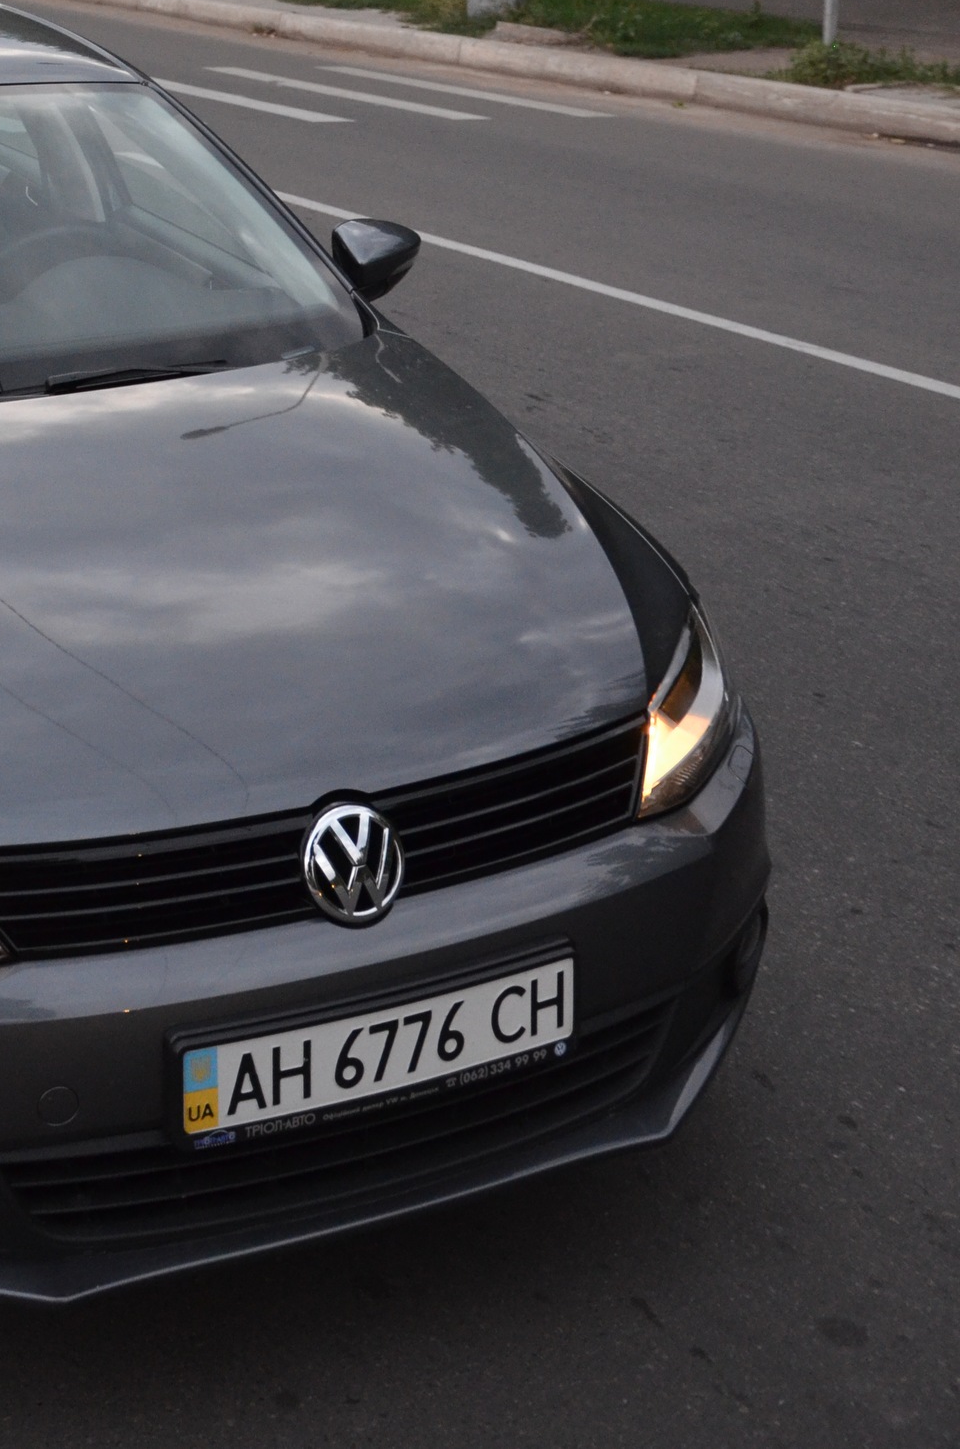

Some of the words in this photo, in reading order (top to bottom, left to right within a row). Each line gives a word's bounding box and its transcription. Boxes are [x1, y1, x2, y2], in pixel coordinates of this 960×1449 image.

[307, 807, 398, 918] VW
[227, 1039, 311, 1116] AH
[334, 1000, 465, 1089] 6776
[491, 970, 564, 1044] CH
[460, 1065, 489, 1086] (062)
[490, 1059, 511, 1075] 334
[515, 1054, 529, 1068] 99
[533, 1048, 547, 1062] 99
[188, 1103, 214, 1122] UA
